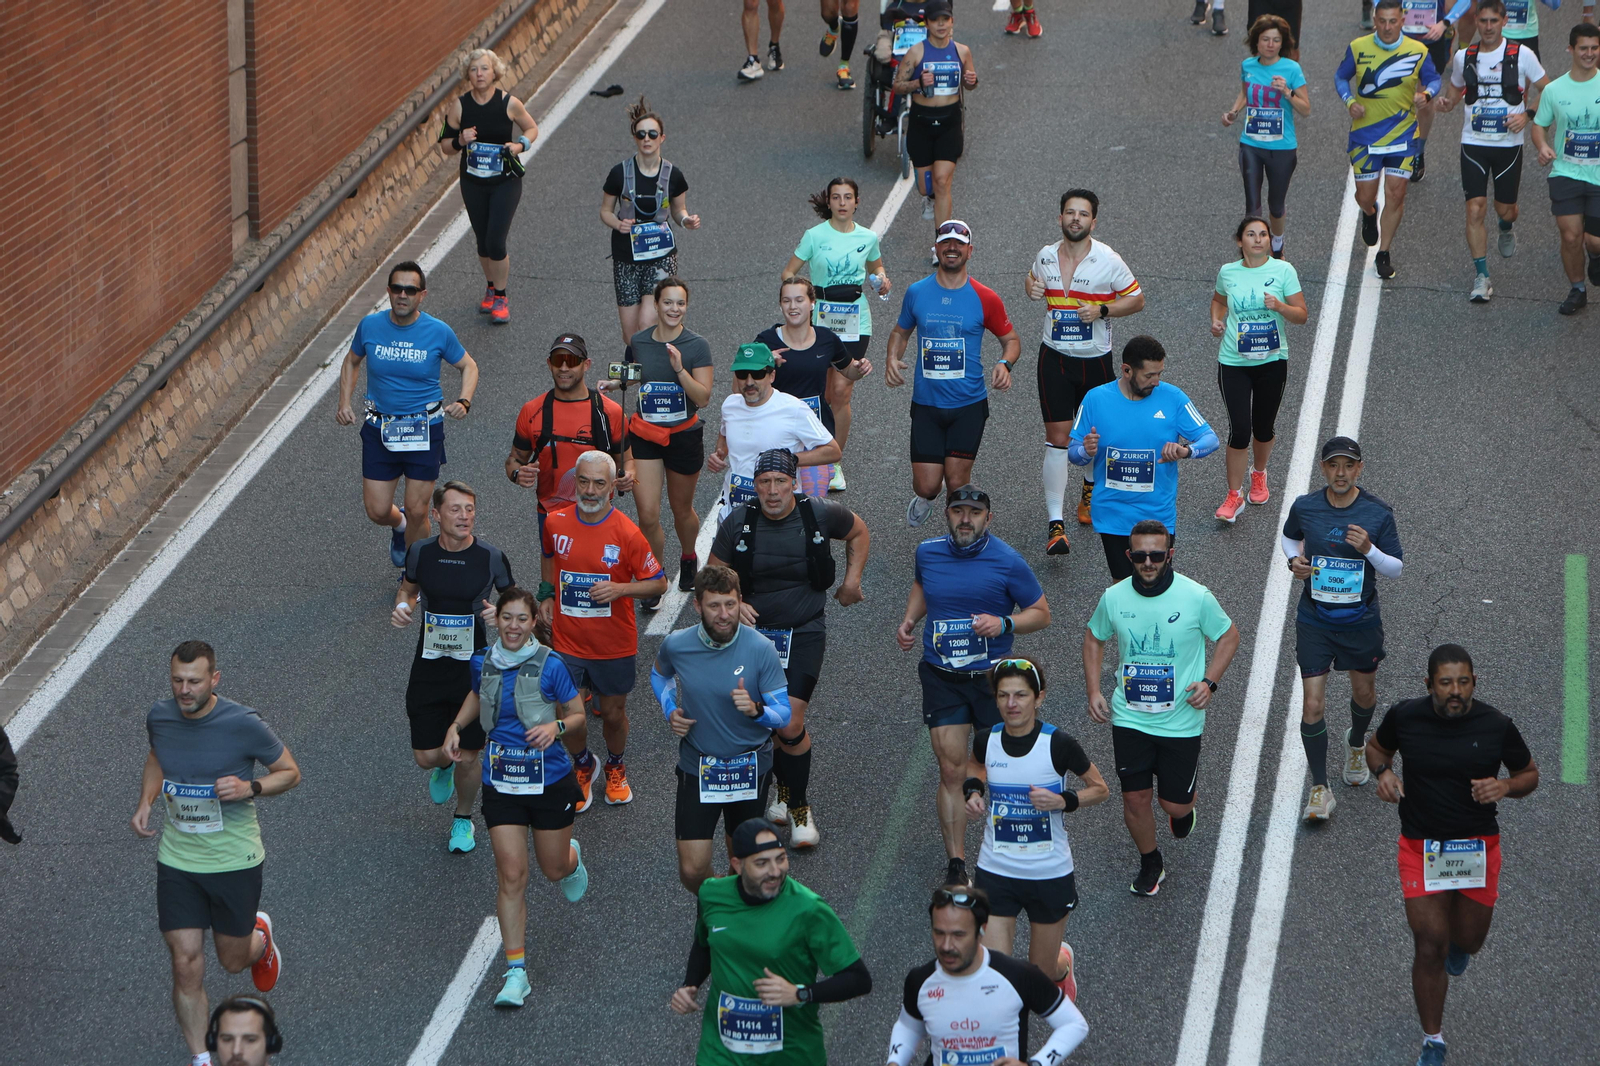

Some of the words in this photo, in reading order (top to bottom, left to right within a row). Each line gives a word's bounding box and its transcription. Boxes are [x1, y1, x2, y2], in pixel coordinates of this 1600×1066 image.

[479, 144, 500, 152] ZURICH
[934, 341, 960, 350] ZURICH
[375, 345, 421, 359] FINISHER
[1121, 467, 1140, 475] 11516
[553, 533, 569, 554] 10
[1329, 560, 1358, 569] ZURICH
[1328, 576, 1345, 584] 5906
[1320, 585, 1353, 593] ABDELLATIF
[574, 590, 591, 598] 1242
[439, 618, 468, 626] ZURICH
[949, 622, 972, 631] ZURIC
[438, 633, 458, 641] 10012
[949, 639, 970, 647] 12080
[952, 649, 968, 657] FRAN
[1138, 684, 1158, 692] 12932
[507, 748, 536, 757] ZURICH
[720, 757, 749, 765] ZURICH
[504, 764, 526, 773] 12618
[718, 773, 740, 781] 12110
[708, 783, 730, 791] WALDO
[731, 782, 750, 790] FALDO
[179, 787, 211, 797] ZURICH
[180, 804, 199, 812] 9417
[1010, 824, 1033, 832] 11970
[1445, 843, 1478, 851] ZURICH
[1438, 870, 1454, 878] JOEL
[1455, 869, 1472, 877] JOSÉ
[738, 1002, 773, 1011] ZURICH
[736, 1020, 762, 1030] 11414
[950, 1017, 980, 1032] edp
[732, 1031, 742, 1040] RO
[743, 1032, 749, 1040] Y
[750, 1033, 778, 1041] AMALIA
[962, 1052, 998, 1063] ZURICH
